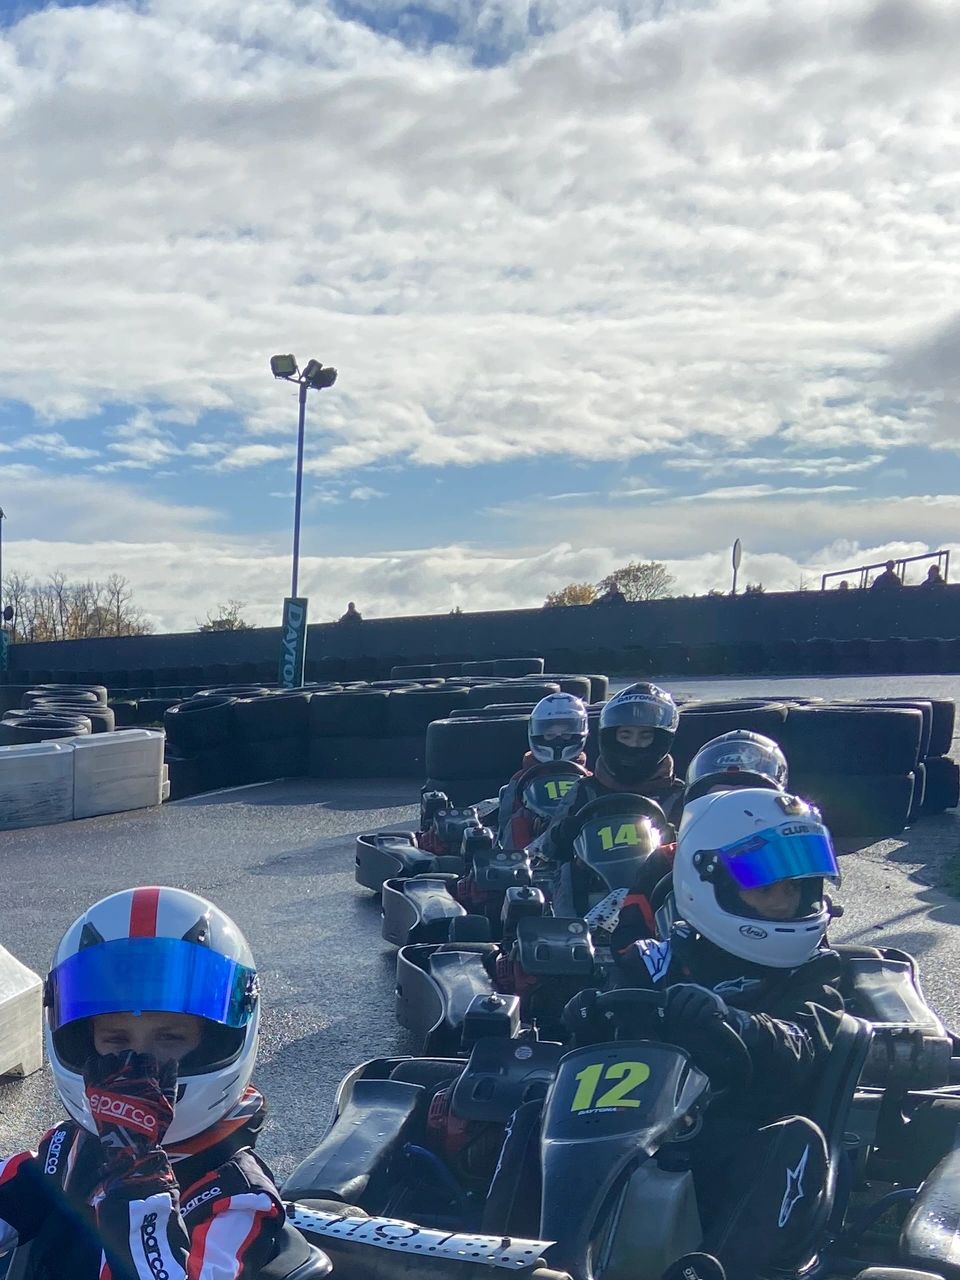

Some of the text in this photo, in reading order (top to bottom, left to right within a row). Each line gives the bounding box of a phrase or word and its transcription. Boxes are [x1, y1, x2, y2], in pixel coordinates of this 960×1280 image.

[597, 823, 640, 850] 14
[742, 926, 765, 938] Arai
[571, 1061, 650, 1112] 12
[90, 1094, 156, 1132] sparco
[45, 1130, 66, 1174] sparco
